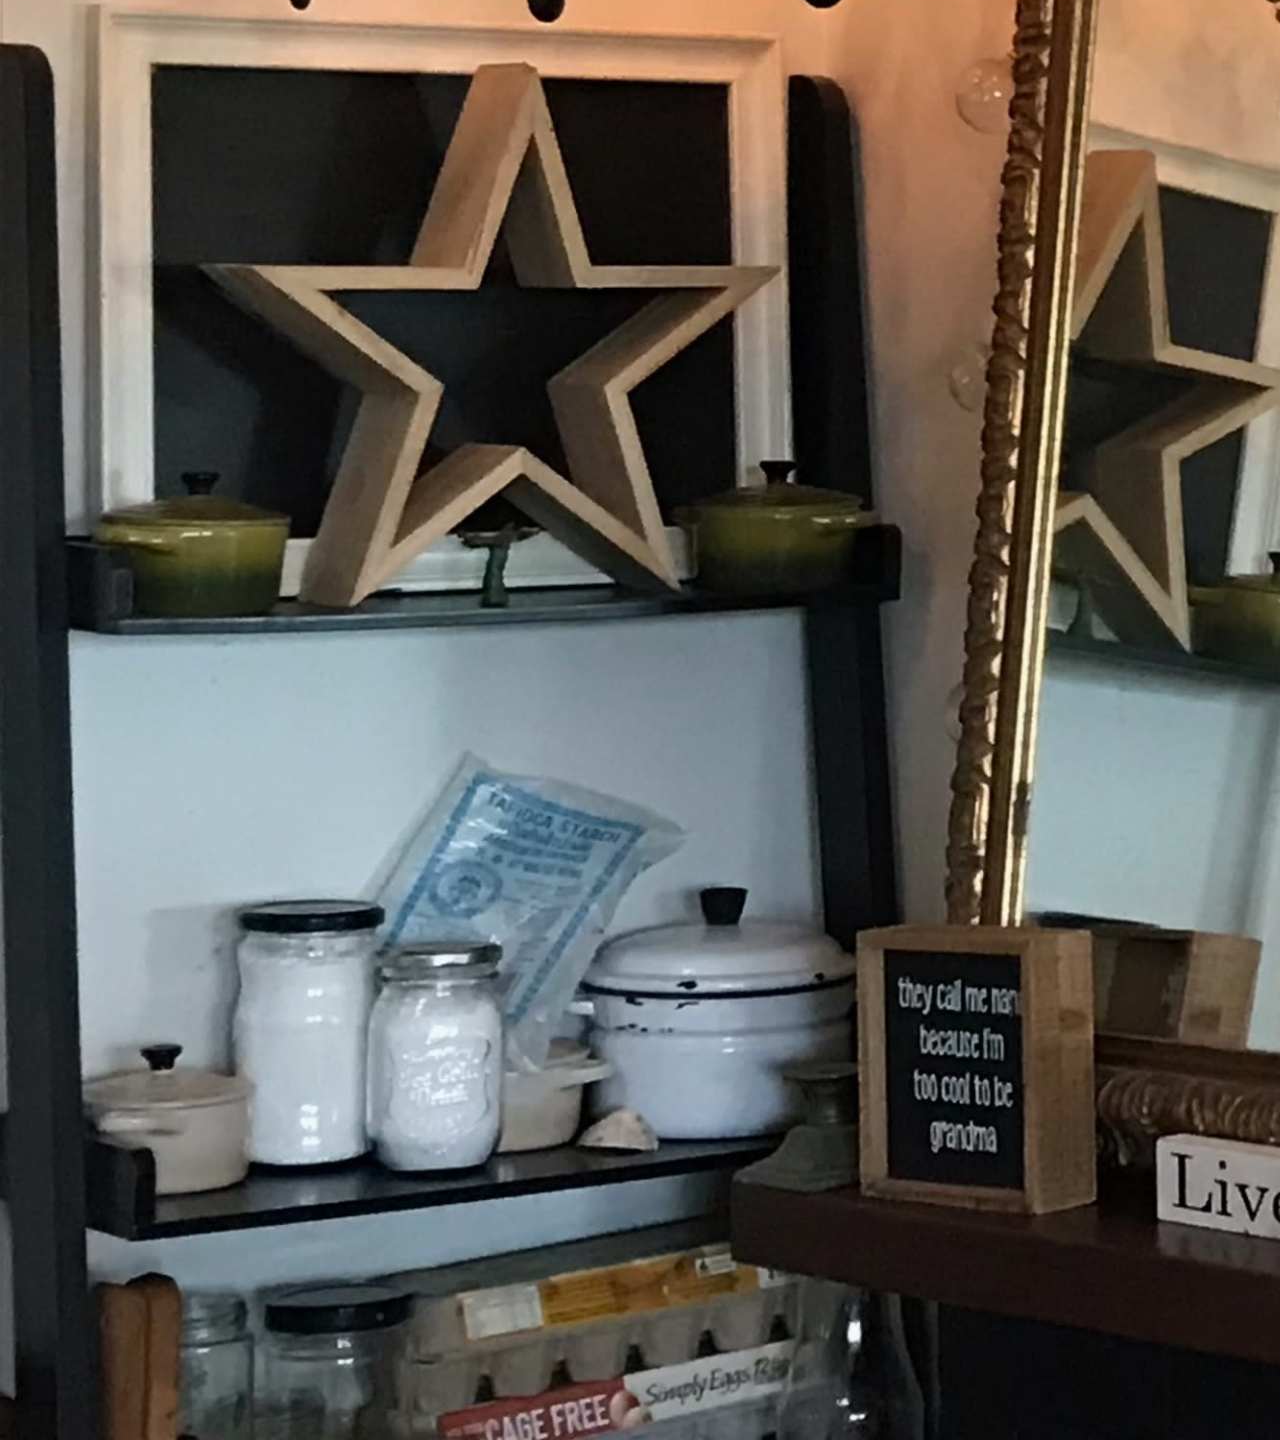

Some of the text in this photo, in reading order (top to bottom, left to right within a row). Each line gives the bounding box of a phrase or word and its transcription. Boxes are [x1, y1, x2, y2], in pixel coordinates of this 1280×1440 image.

[898, 977, 933, 1015] they
[936, 979, 962, 1011] call
[965, 986, 988, 1013] me
[919, 1023, 980, 1059] because
[913, 1068, 1014, 1108] too cool to be
[930, 1120, 998, 1154] grandma
[645, 1373, 708, 1406] Simply
[708, 1366, 751, 1394] Eggs
[484, 1408, 549, 1440] CAGE
[551, 1394, 611, 1437] FREE
